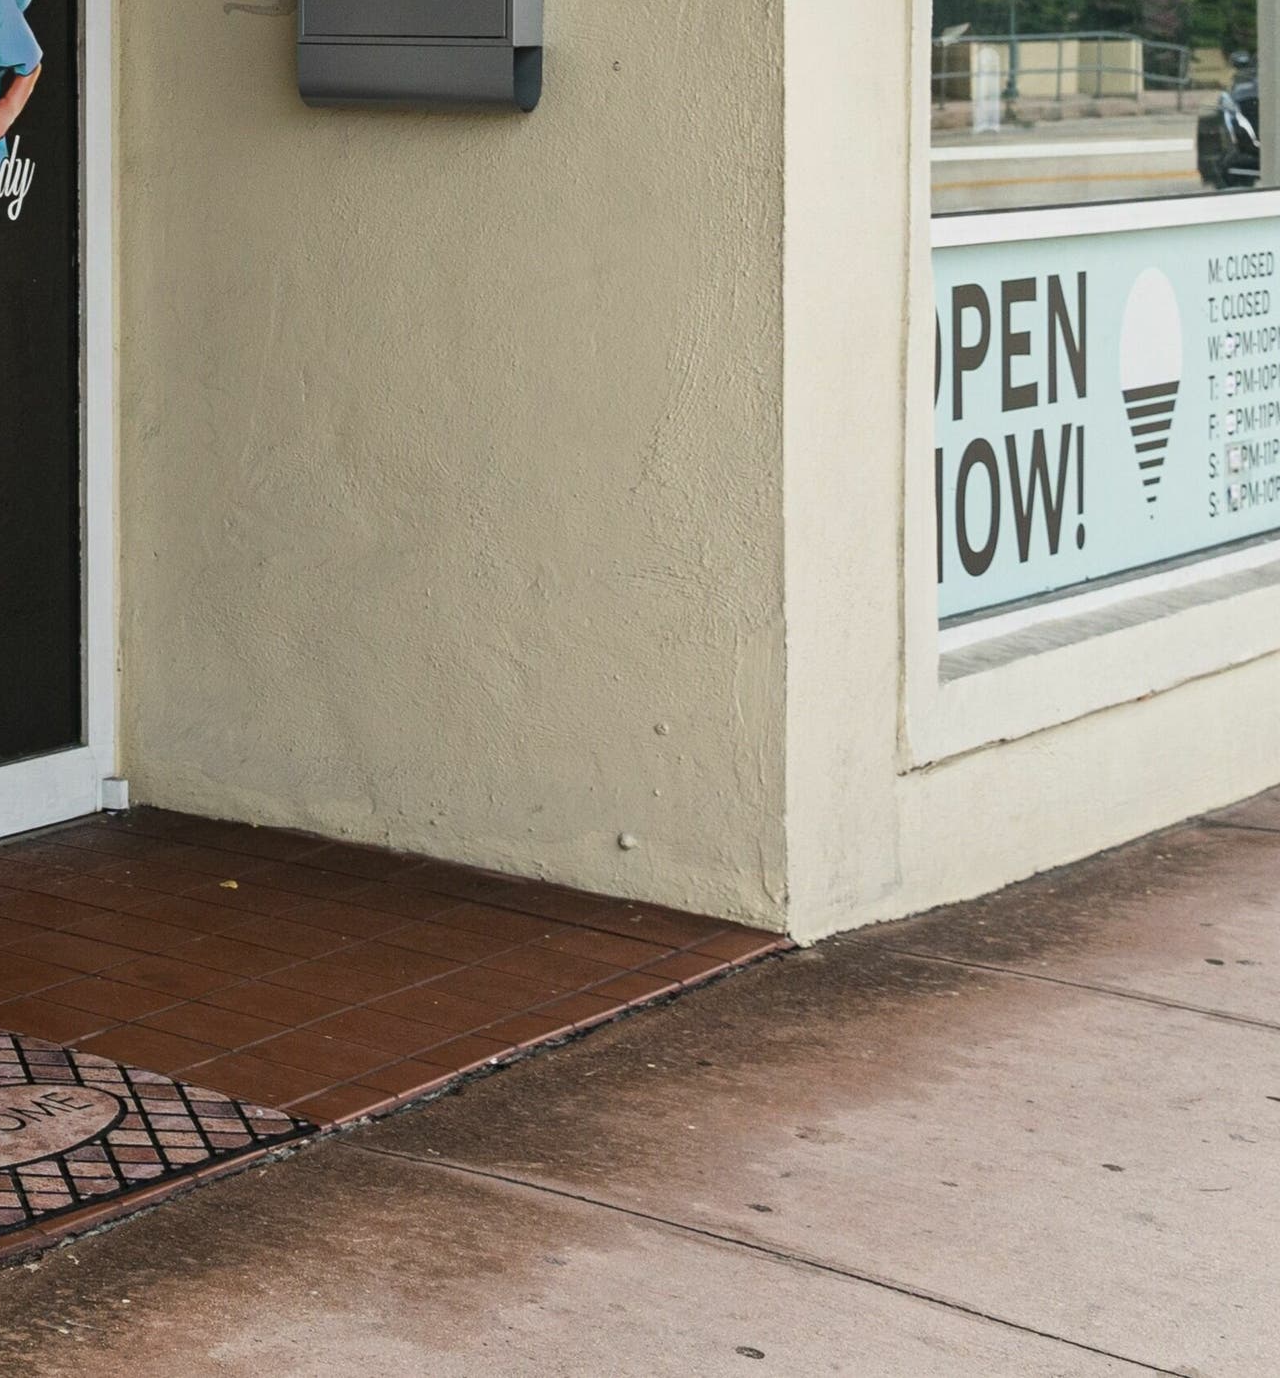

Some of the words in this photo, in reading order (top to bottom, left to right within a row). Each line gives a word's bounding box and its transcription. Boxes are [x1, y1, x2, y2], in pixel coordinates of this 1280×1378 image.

[1221, 289, 1270, 321] CLOSED
[1225, 251, 1274, 282] CLOSED
[934, 270, 1087, 421] PEN
[934, 422, 1086, 585] OW!
